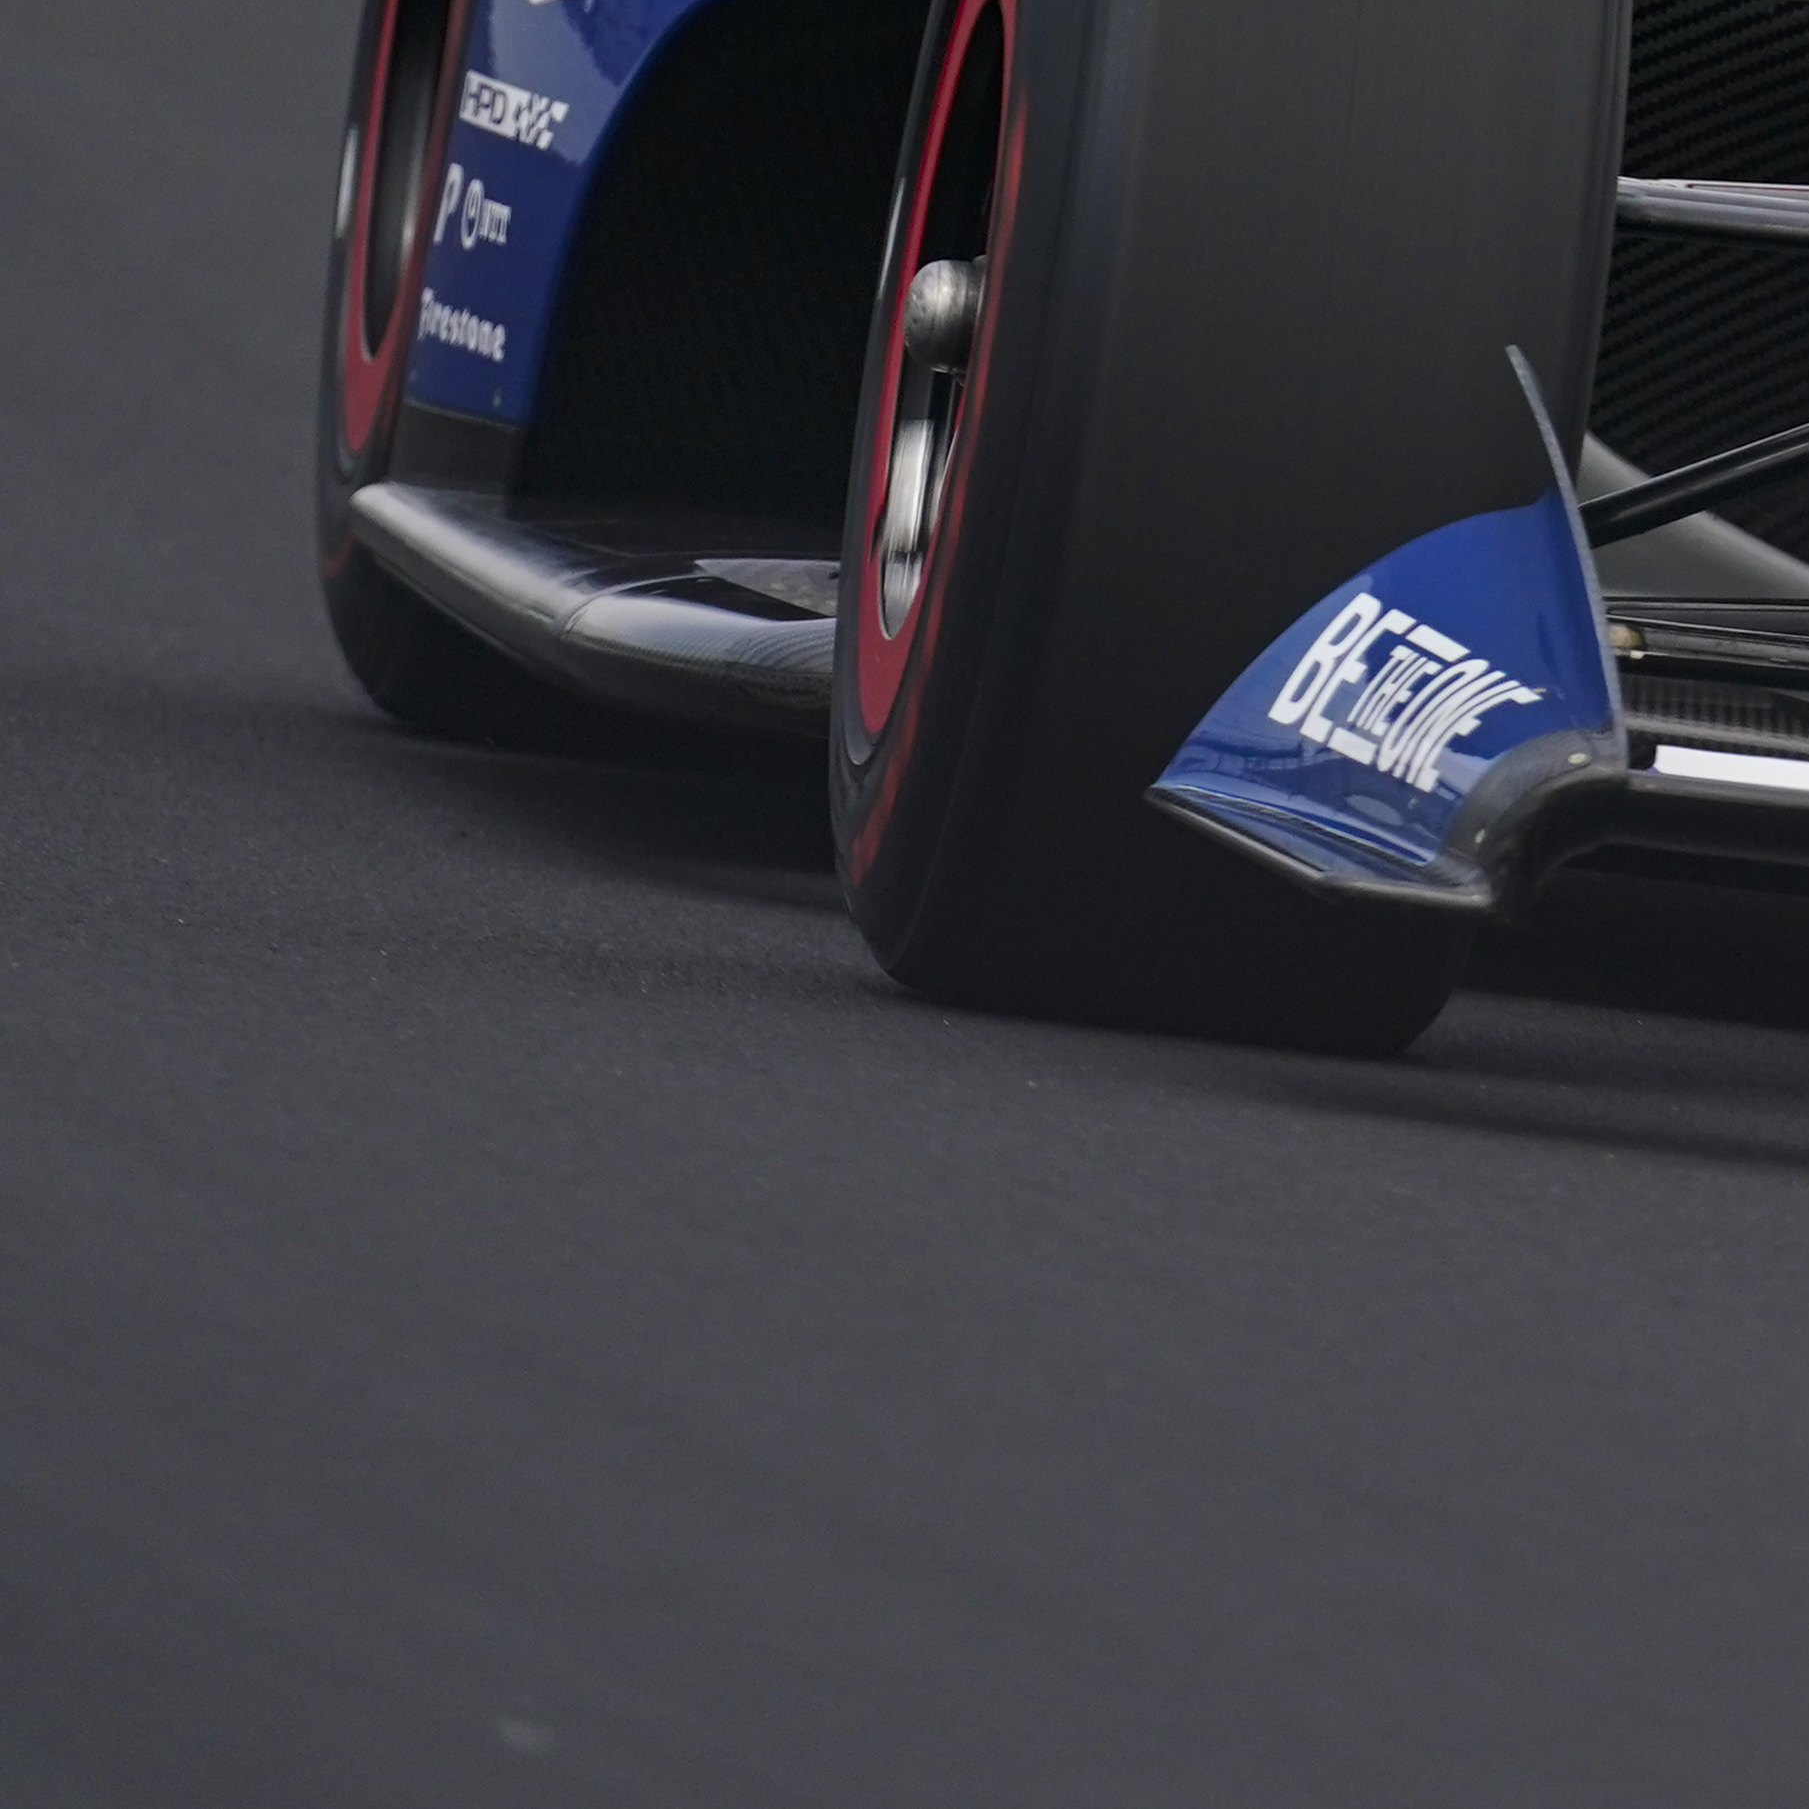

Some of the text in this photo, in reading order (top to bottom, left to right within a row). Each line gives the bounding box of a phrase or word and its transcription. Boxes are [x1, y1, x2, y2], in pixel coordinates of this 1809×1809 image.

[1267, 591, 1545, 793] BE THE ONE
